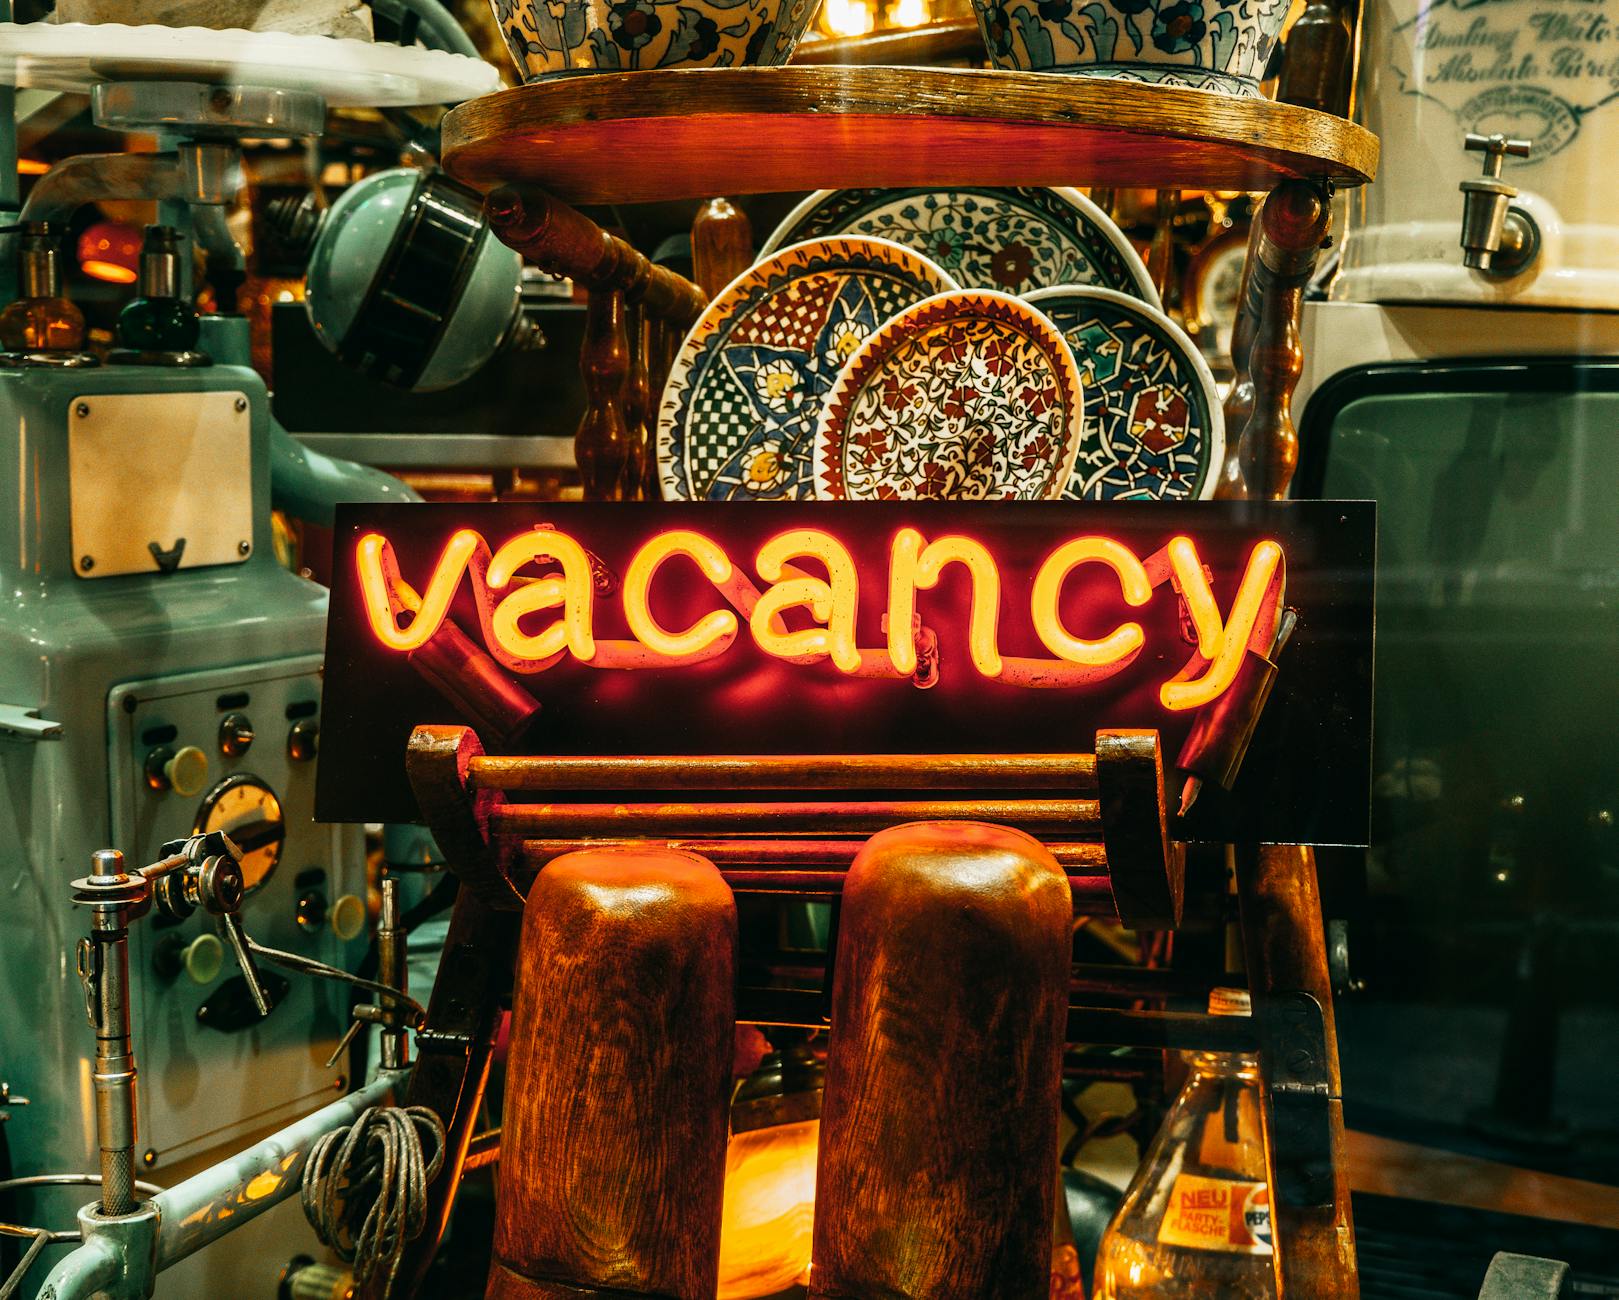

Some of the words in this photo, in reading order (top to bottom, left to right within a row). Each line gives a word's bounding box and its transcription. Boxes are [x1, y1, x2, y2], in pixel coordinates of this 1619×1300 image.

[1528, 11, 1619, 43] Wate
[355, 526, 1285, 711] vacancy
[1181, 1190, 1227, 1208] NEU
[1170, 1218, 1226, 1237] FLASCHE
